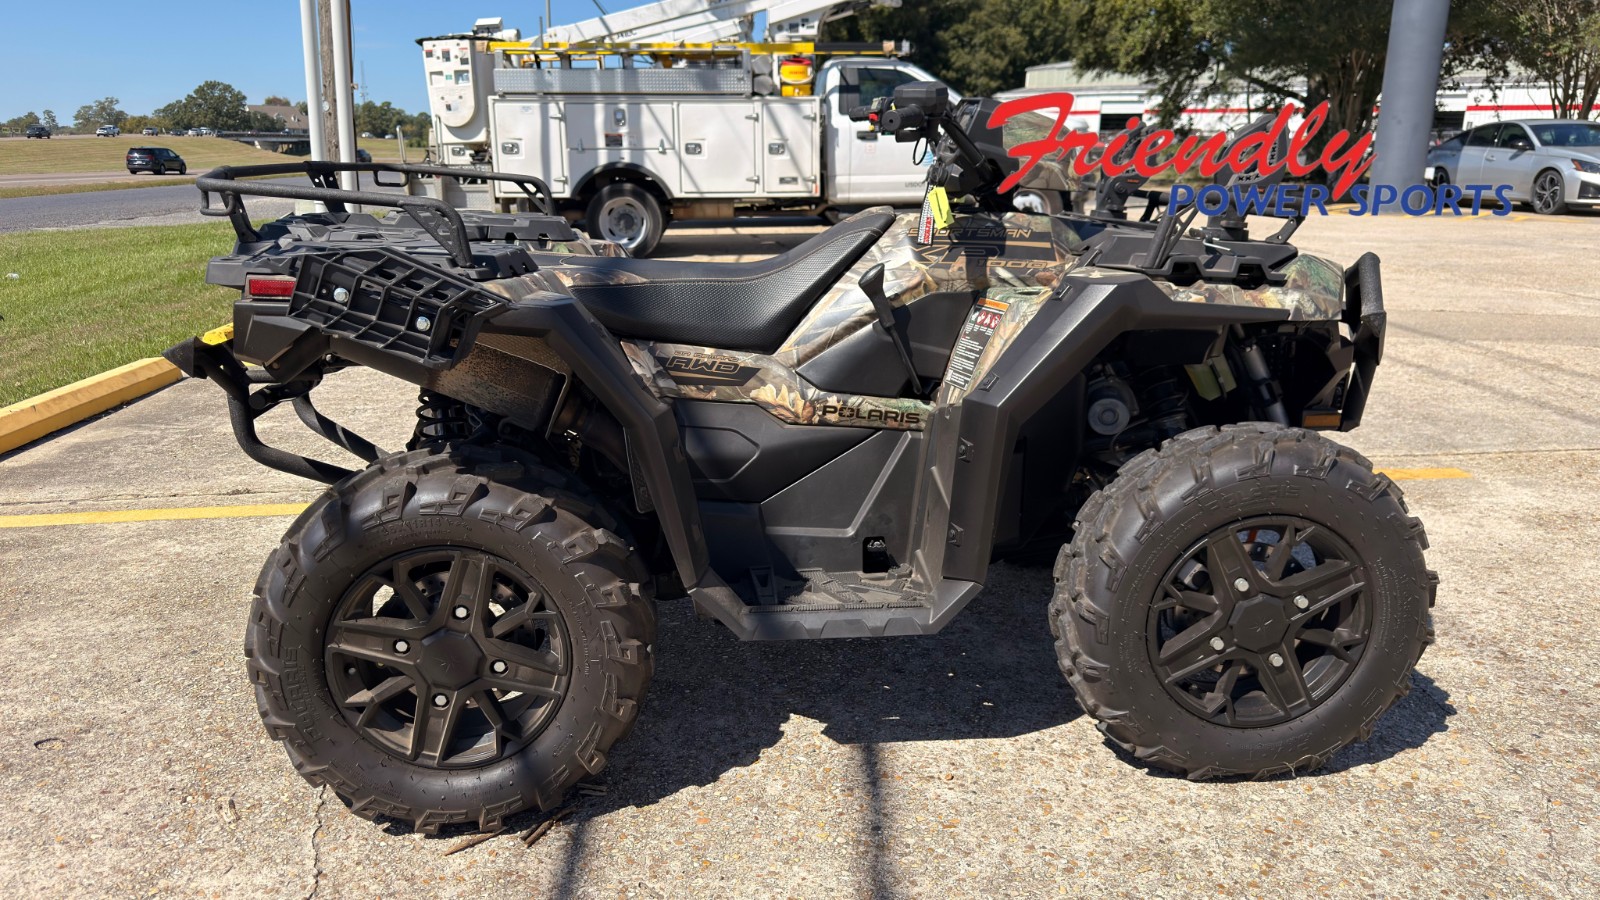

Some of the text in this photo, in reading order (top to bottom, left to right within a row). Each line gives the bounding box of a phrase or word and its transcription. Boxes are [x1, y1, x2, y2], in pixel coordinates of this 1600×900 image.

[907, 228, 1032, 239] SORTSMAN
[665, 355, 741, 374] AWD
[822, 404, 920, 424] POLARIS
